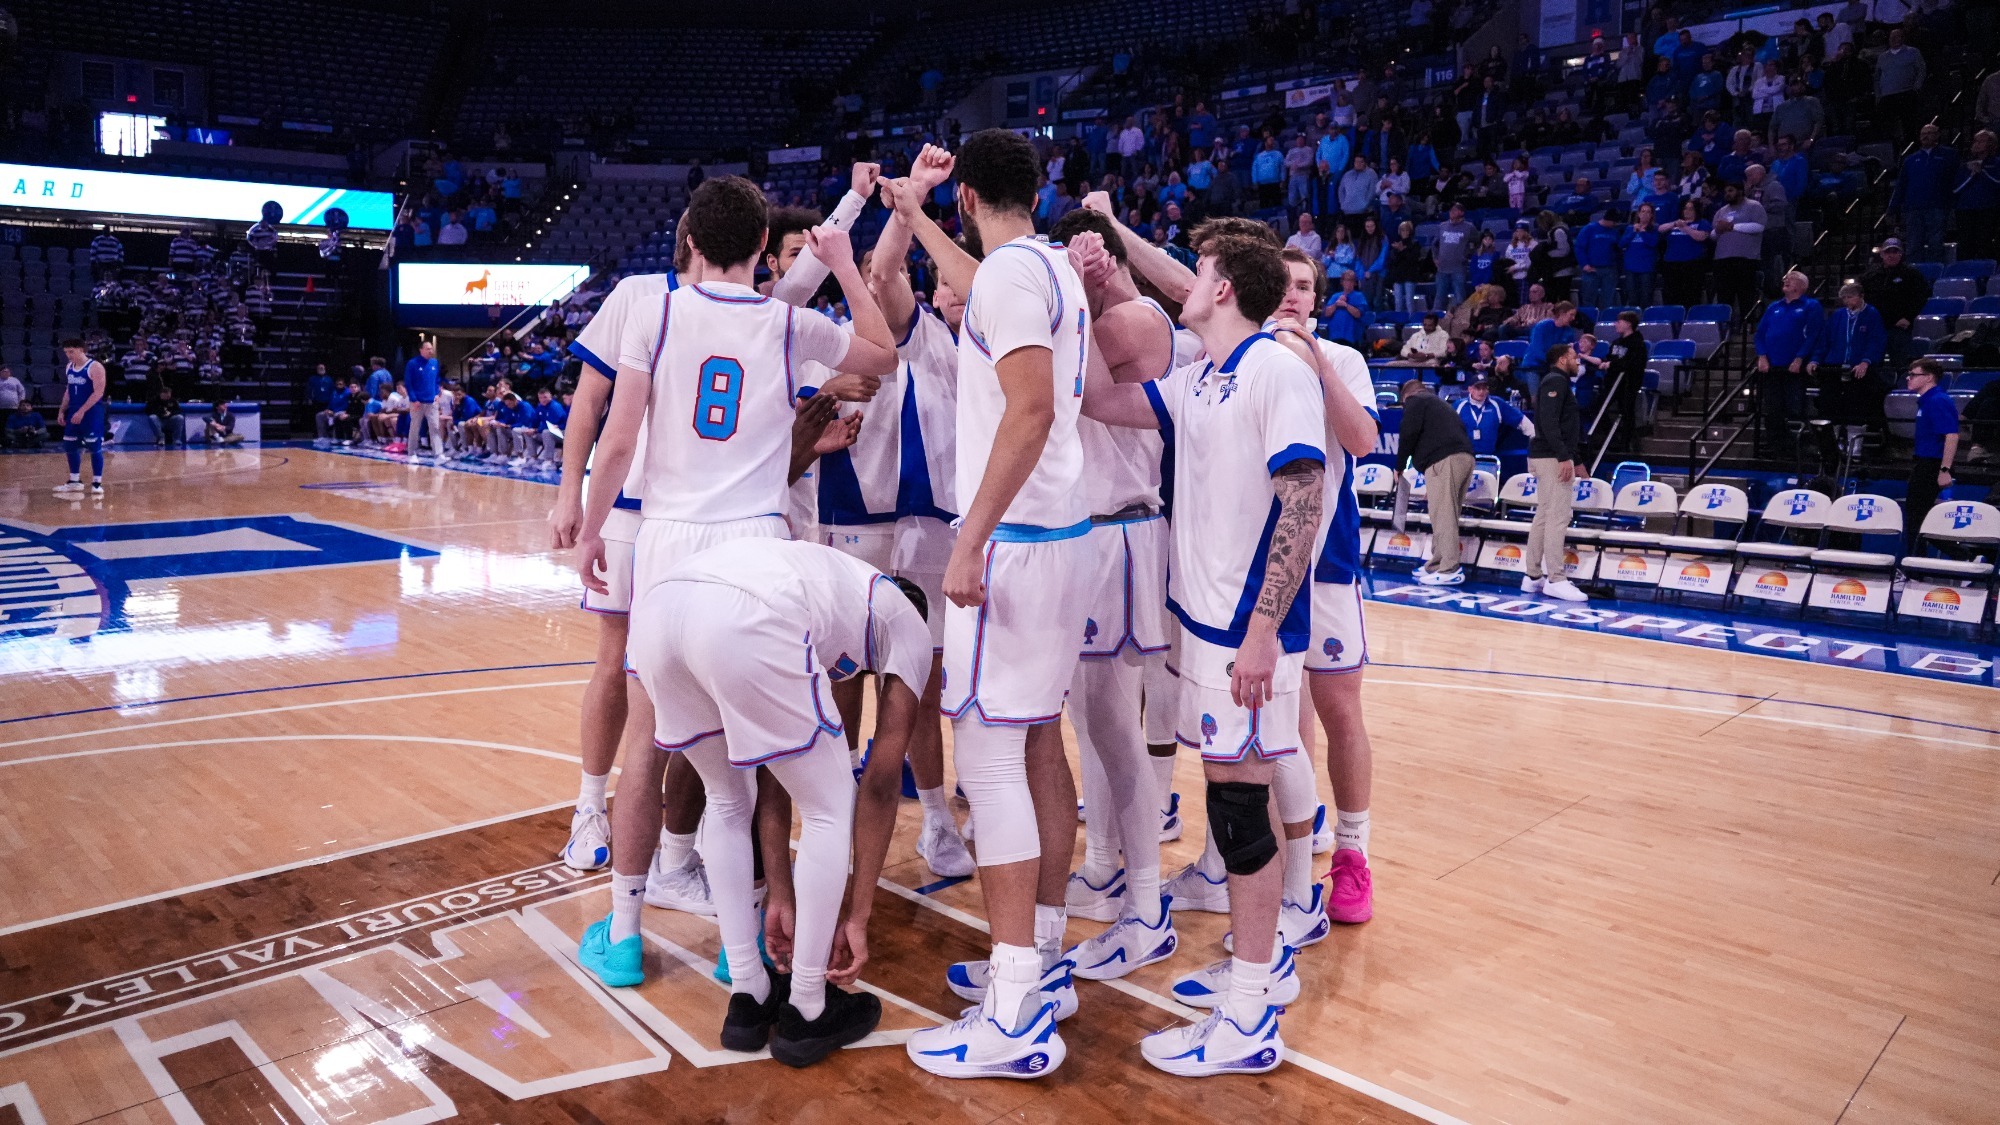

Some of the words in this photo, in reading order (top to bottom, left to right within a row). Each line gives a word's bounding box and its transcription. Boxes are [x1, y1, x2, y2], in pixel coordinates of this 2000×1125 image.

[1435, 70, 1453, 81] 116
[693, 355, 744, 441] 8
[1700, 446, 1707, 455] A
[1679, 576, 1710, 584] HAMILTON
[1755, 584, 1786, 593] HAMILTON
[1830, 593, 1866, 602] HAMILTON
[1922, 601, 1960, 611] HAMILTON
[1372, 585, 1898, 660] PROSPECT
[1911, 652, 2000, 681] B
[63, 936, 324, 1017] VALLEY
